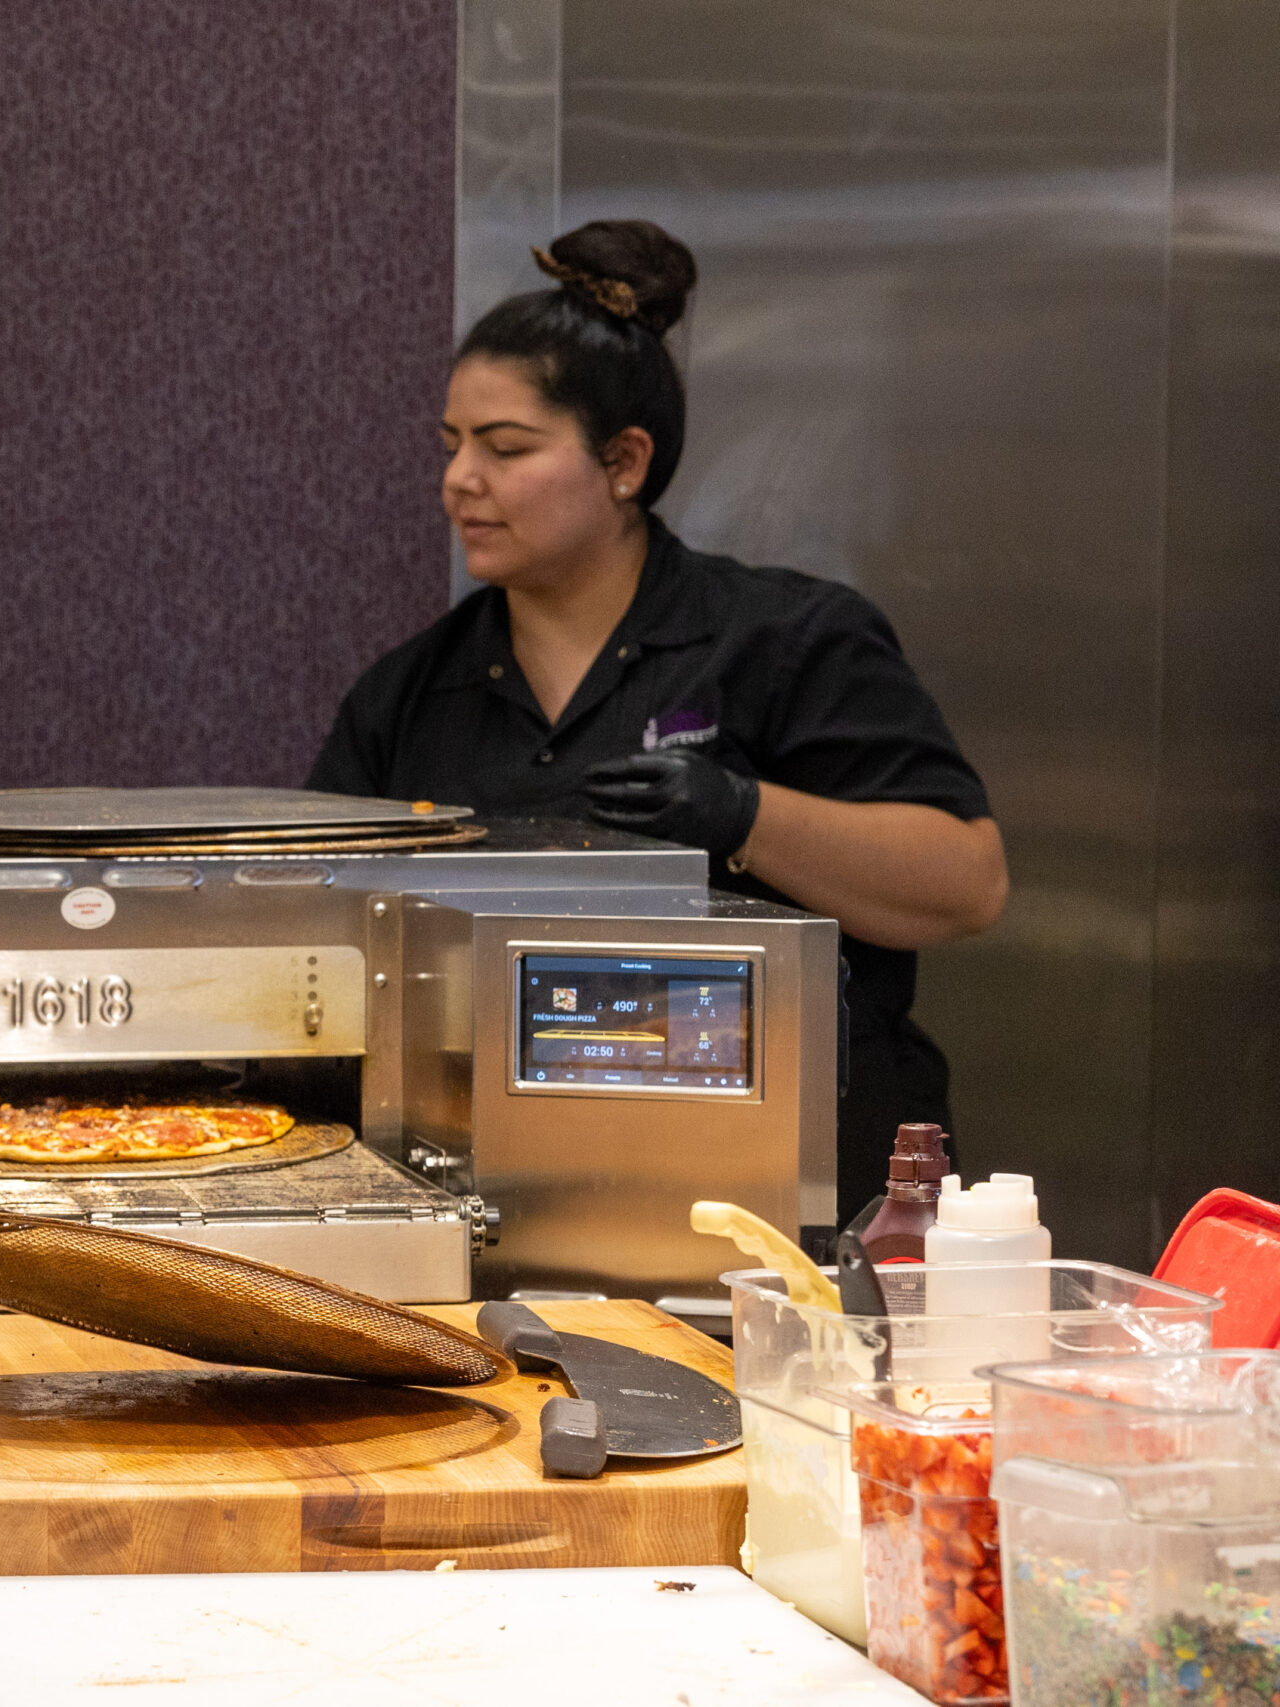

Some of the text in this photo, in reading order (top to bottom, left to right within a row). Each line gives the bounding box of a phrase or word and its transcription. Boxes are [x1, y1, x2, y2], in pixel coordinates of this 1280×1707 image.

[2, 974, 134, 1028] 1618
[533, 1013, 597, 1023] FRESH DOUGH PIZZA
[583, 1045, 614, 1057] 02:50
